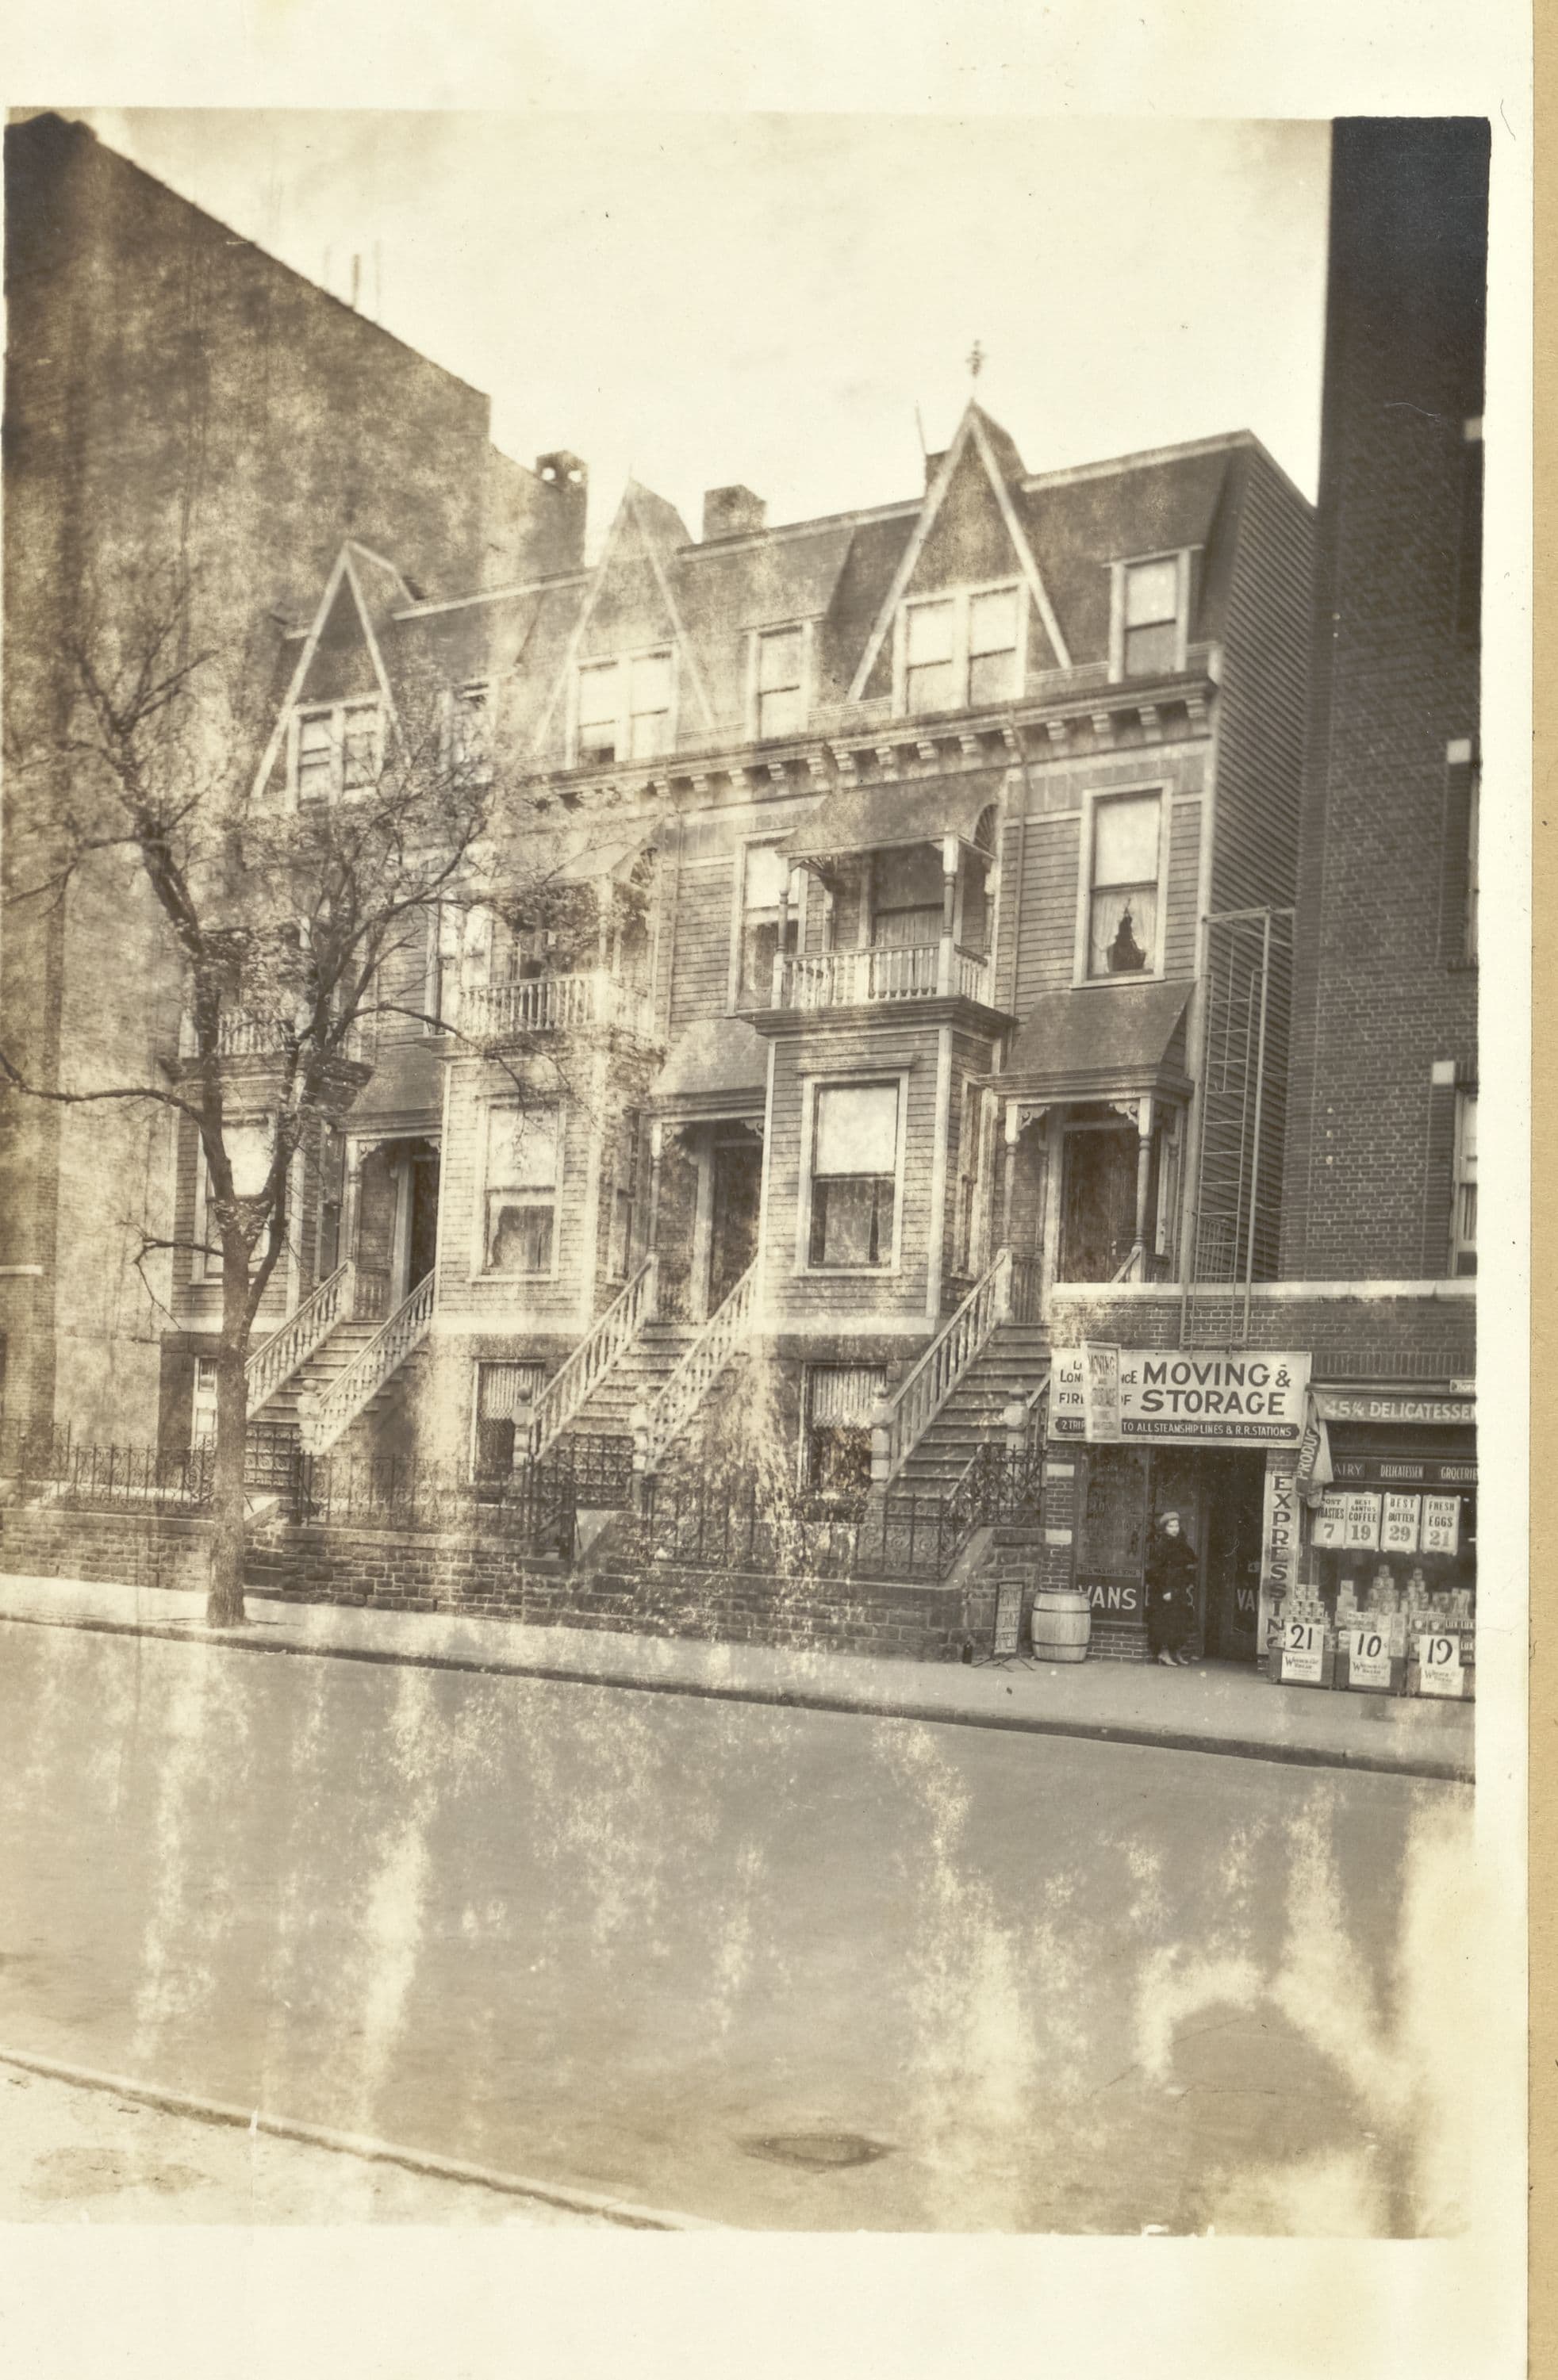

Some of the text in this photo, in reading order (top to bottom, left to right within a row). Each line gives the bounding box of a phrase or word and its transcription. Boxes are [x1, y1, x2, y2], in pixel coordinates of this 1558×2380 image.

[1060, 1369, 1084, 1383] LON
[1143, 1362, 1270, 1387] MOVING
[1275, 1370, 1291, 1388] &
[1140, 1389, 1286, 1416] STORAGE
[1122, 1422, 1134, 1431] TO
[1137, 1423, 1153, 1432] ALL
[1154, 1423, 1199, 1433] STEAMSHIP
[1200, 1424, 1223, 1434] LINES
[1226, 1425, 1233, 1435] &
[1296, 1428, 1318, 1480] PRODUC
[1334, 1463, 1363, 1476] AIRY
[1441, 1466, 1477, 1481] GROCERIE
[1390, 1497, 1414, 1508] BEST
[1429, 1500, 1455, 1511] FRESH
[1349, 1512, 1377, 1523] COFFEE
[1388, 1512, 1414, 1523] BUTTER
[1429, 1515, 1453, 1527] EGGS
[1323, 1523, 1334, 1539] 7
[1351, 1524, 1372, 1541] 19
[1388, 1524, 1410, 1543] 29
[1429, 1530, 1450, 1547] 21
[1079, 1585, 1137, 1610] VANS
[1237, 1588, 1260, 1612] VA
[1290, 1623, 1313, 1650] 21
[1357, 1632, 1382, 1658] 10
